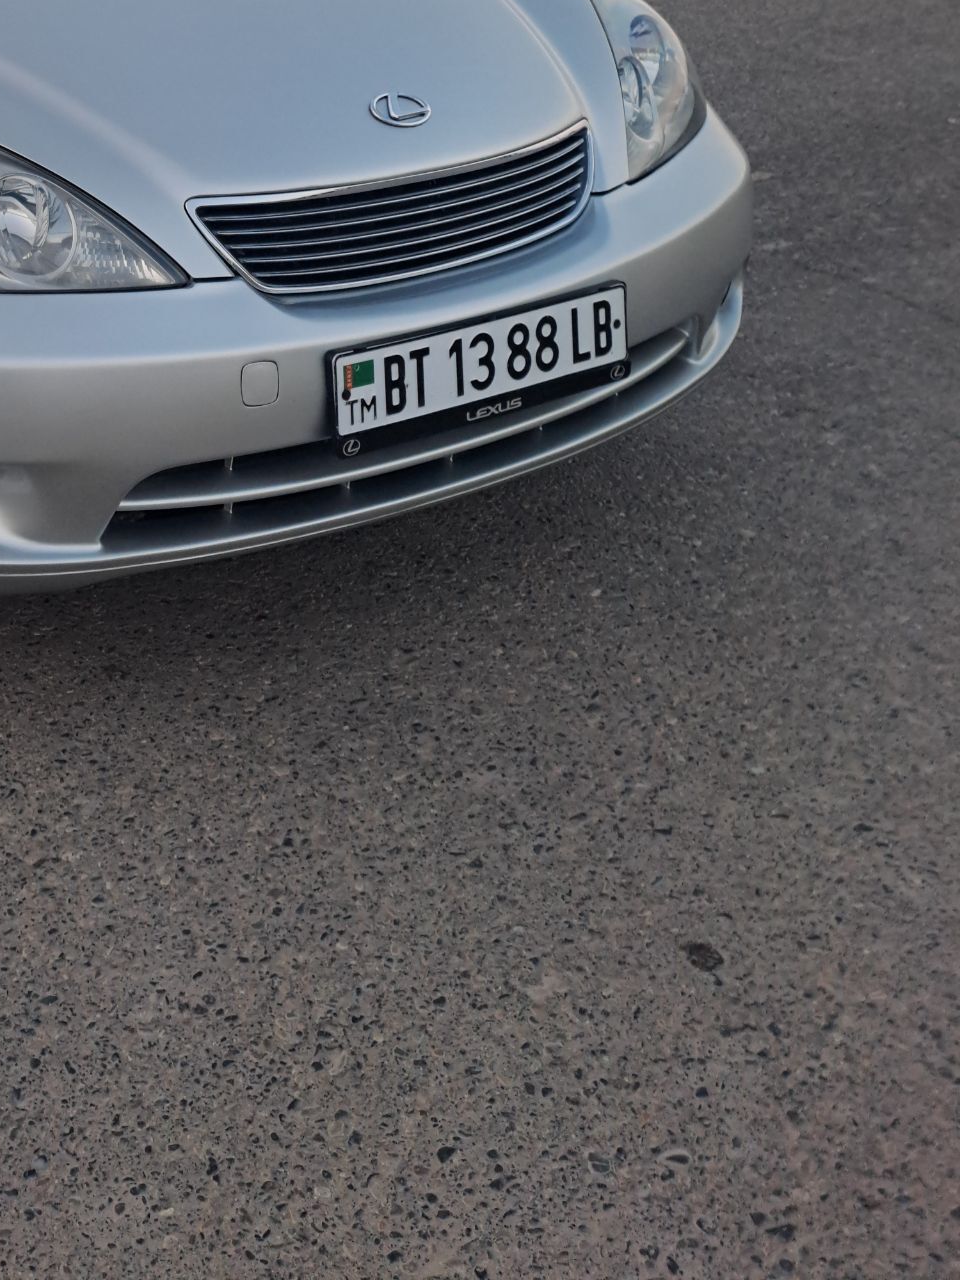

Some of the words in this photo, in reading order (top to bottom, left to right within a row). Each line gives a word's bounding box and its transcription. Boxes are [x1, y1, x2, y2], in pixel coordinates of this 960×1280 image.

[383, 347, 430, 416] BT
[571, 300, 613, 365] LB
[345, 395, 377, 426] TM
[466, 397, 522, 422] LEXUS
